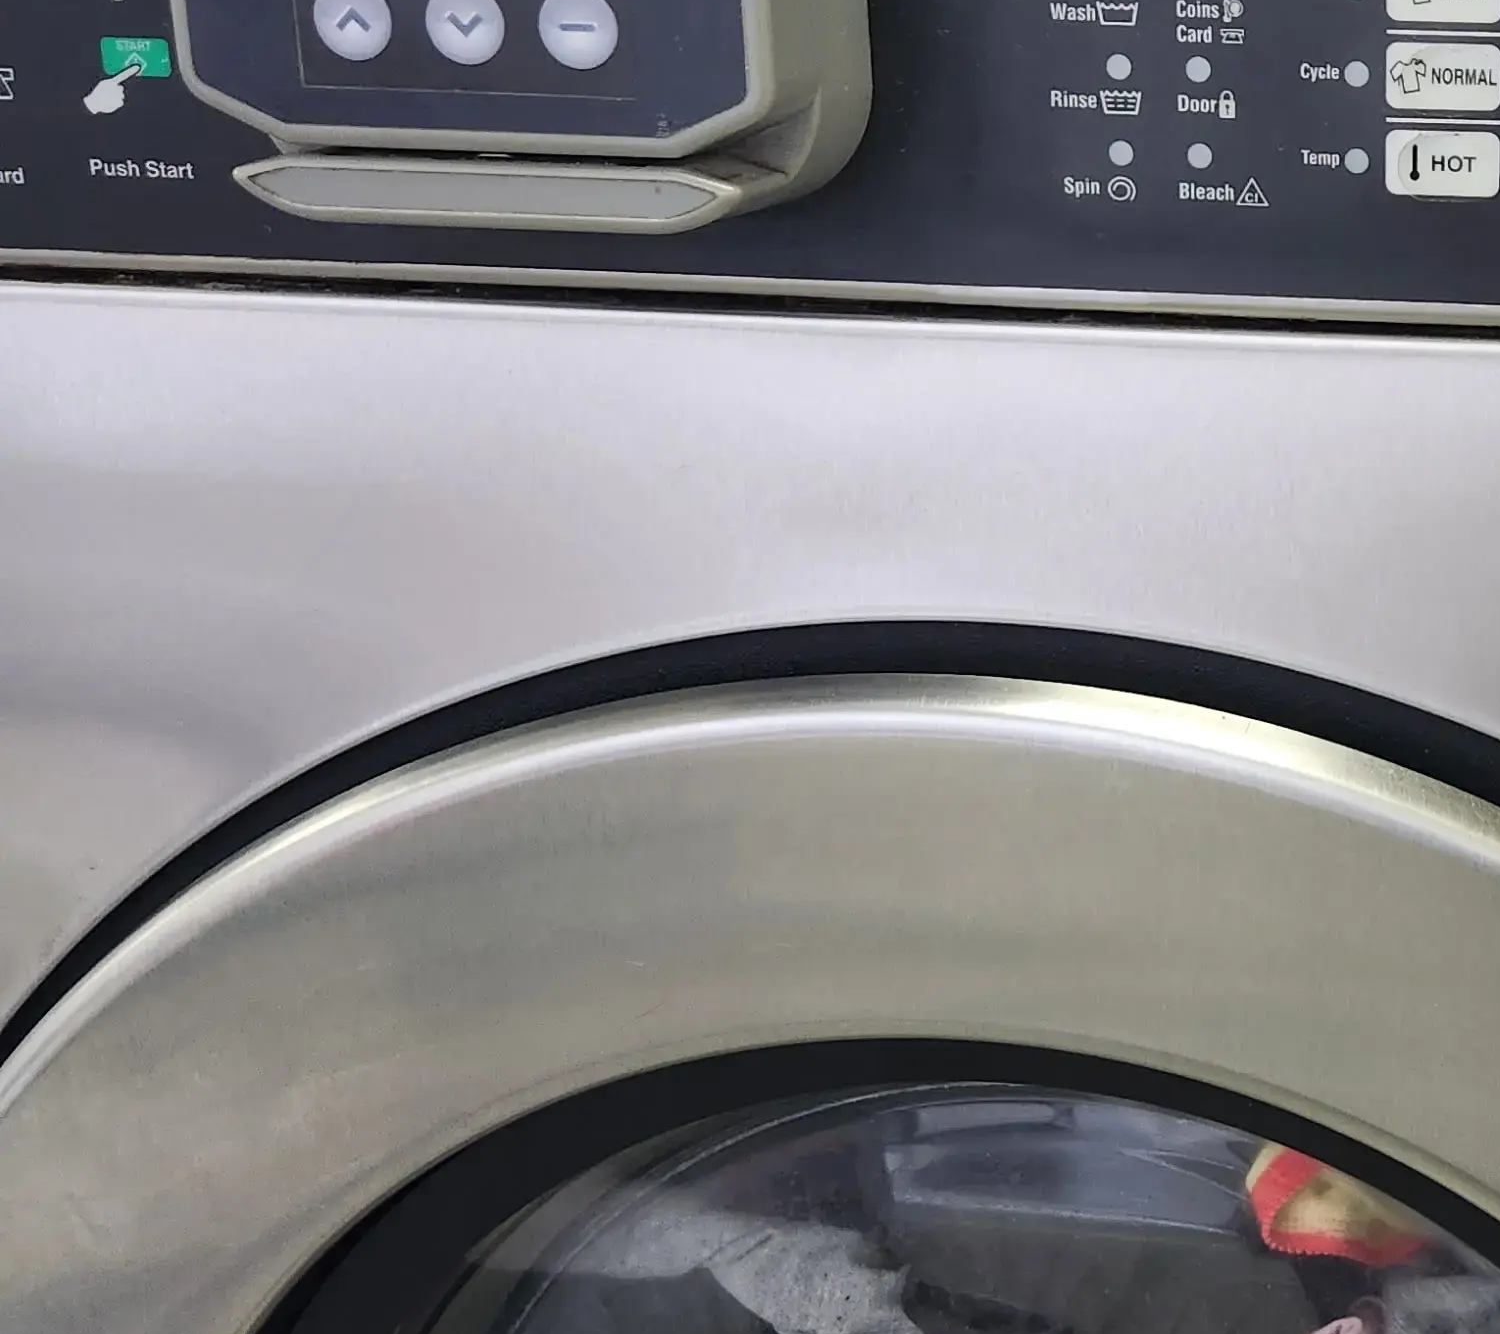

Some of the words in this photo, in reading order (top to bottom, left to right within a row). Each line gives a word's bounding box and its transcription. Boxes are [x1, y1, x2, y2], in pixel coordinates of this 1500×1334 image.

[1050, 2, 1097, 22] Wash
[1176, 0, 1220, 19] Coins
[1176, 25, 1213, 44] Card
[115, 40, 151, 52] START
[1300, 63, 1340, 84] Cycle
[1431, 67, 1498, 88] NORMAL
[1050, 90, 1098, 109] Rinse
[1177, 95, 1218, 114] Door
[89, 158, 141, 178] Push
[145, 160, 195, 181] Start
[1301, 150, 1341, 170] Temp
[1431, 154, 1477, 174] HOT
[1063, 177, 1101, 199] Spin
[1179, 182, 1236, 202] Bleach
